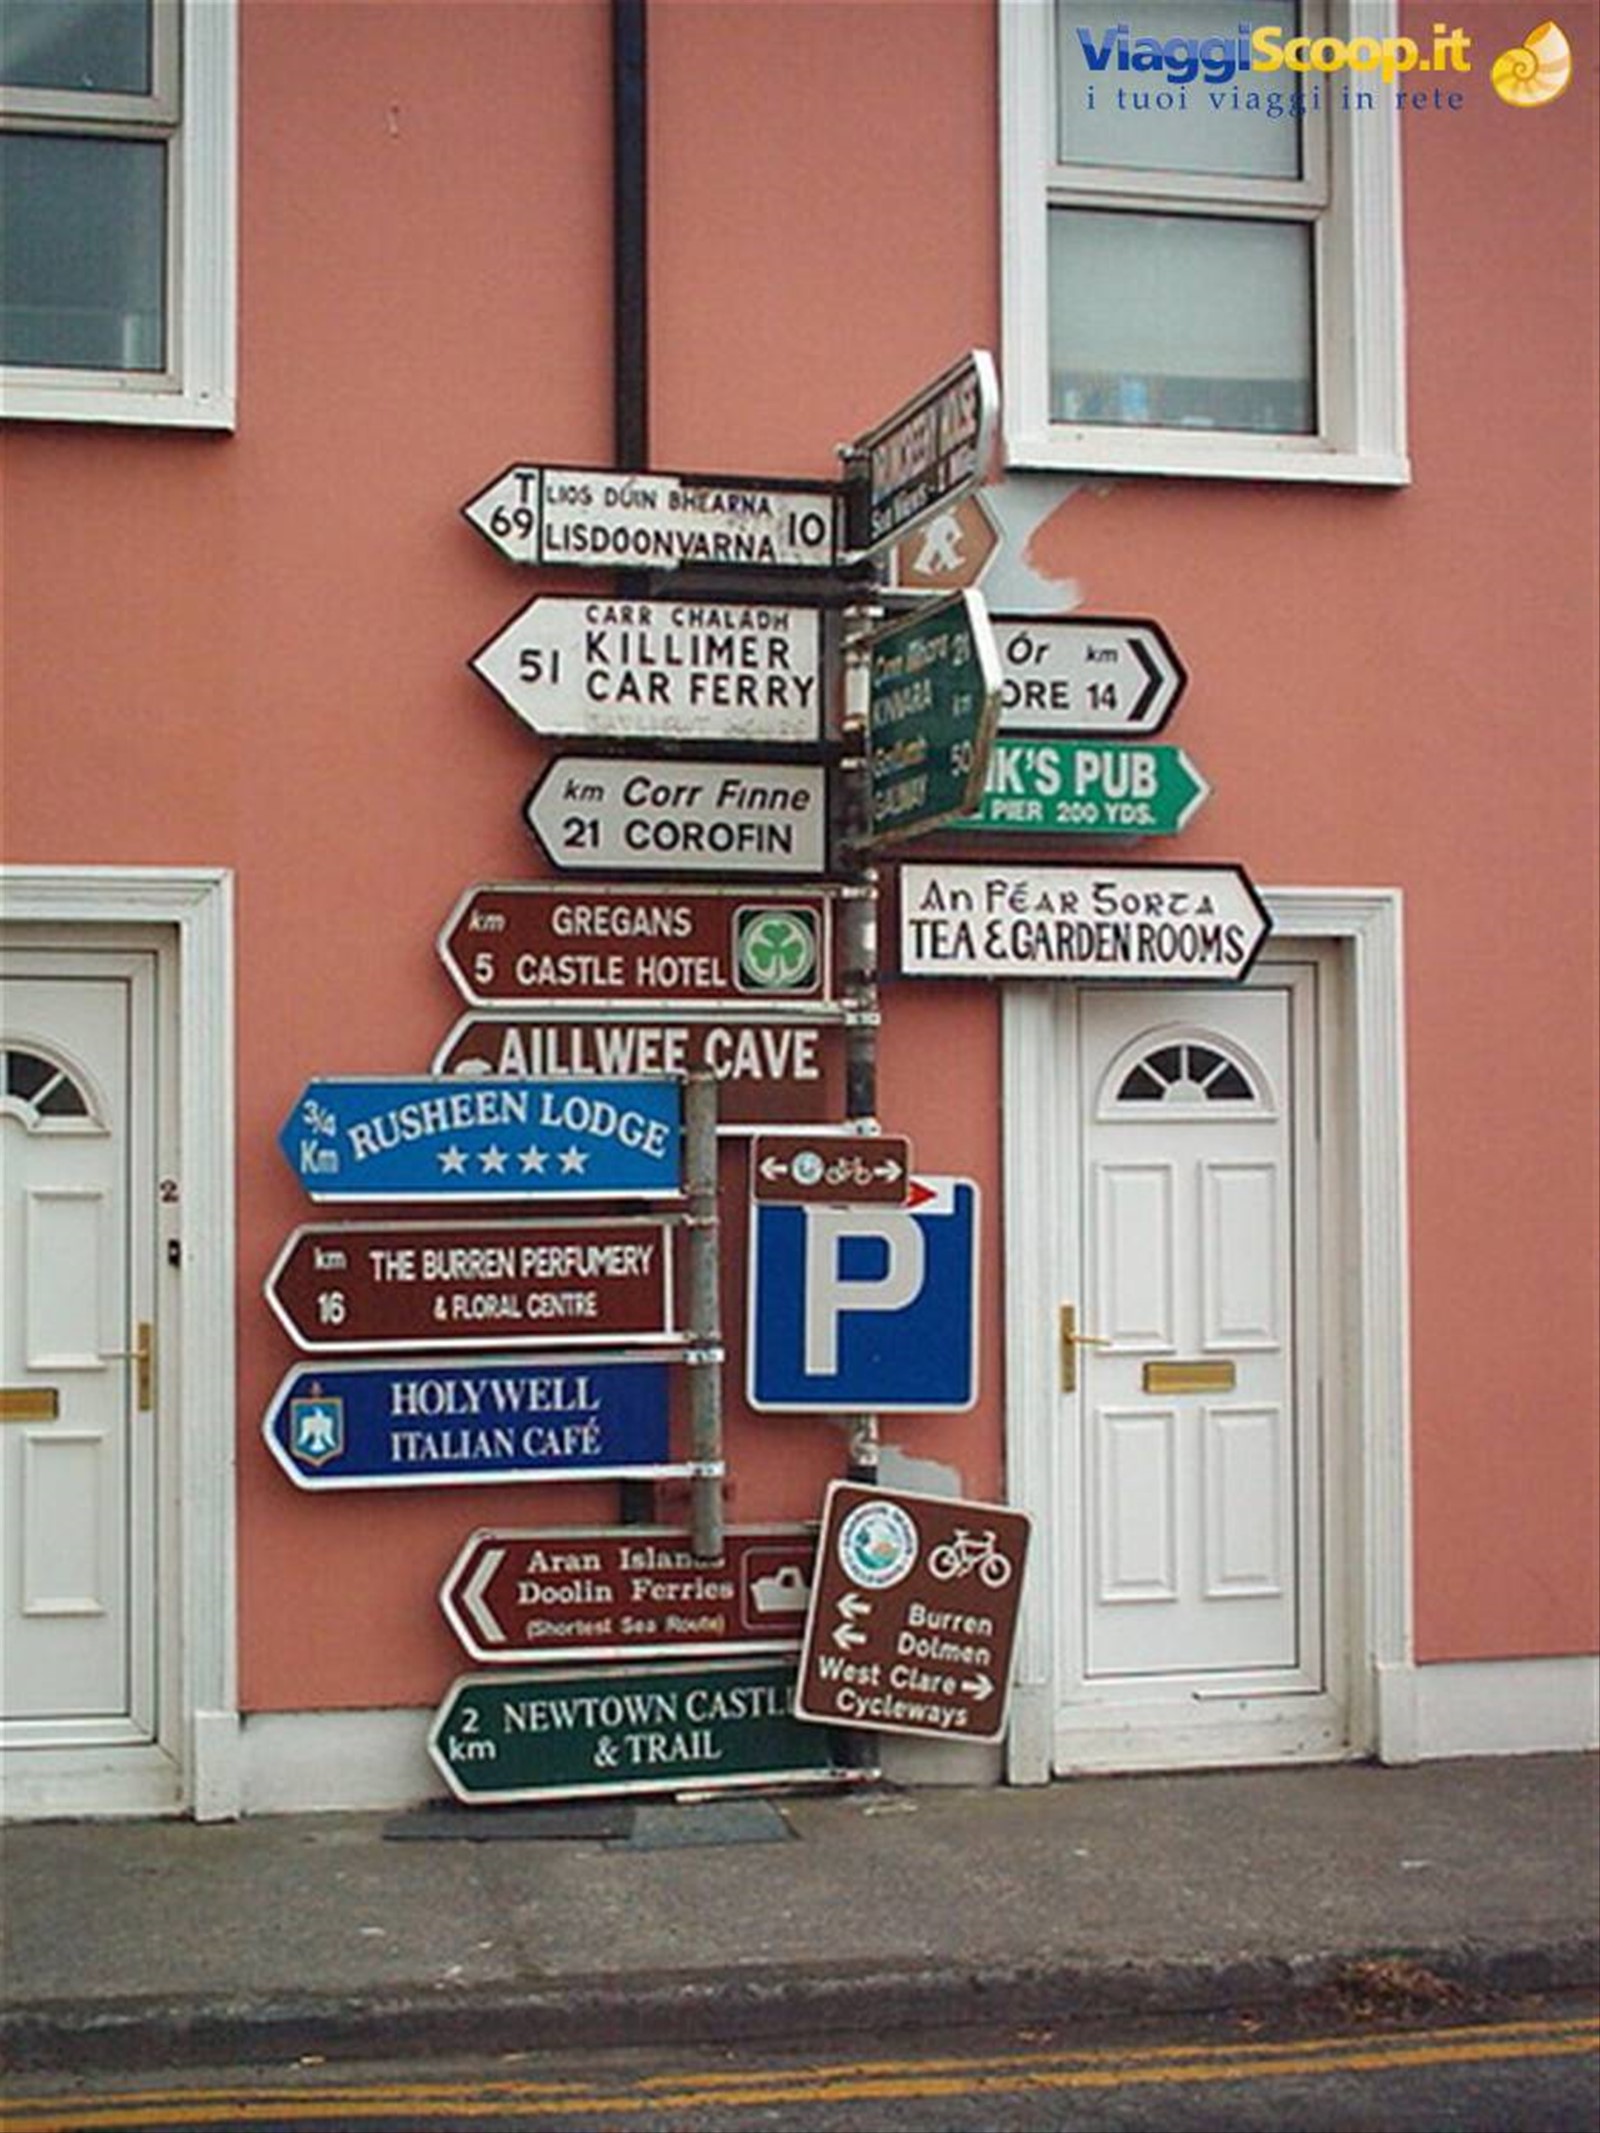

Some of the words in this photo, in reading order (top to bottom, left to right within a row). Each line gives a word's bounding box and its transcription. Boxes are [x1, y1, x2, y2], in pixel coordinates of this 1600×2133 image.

[513, 472, 535, 504] T
[547, 485, 593, 507] LIOS
[669, 491, 774, 516] BHEARNA
[490, 505, 535, 539] 69
[788, 512, 826, 548] 10
[546, 524, 777, 562] LISDOONVARNA
[586, 604, 651, 625] CARR
[671, 607, 789, 631] CHALADH
[586, 631, 790, 670] KILLIMER
[1006, 631, 1050, 665] Ór
[1087, 645, 1119, 663] km
[519, 649, 559, 685] 51
[586, 670, 671, 703] CAR
[690, 673, 815, 709] FERRY
[1087, 683, 1117, 709] 14
[1075, 751, 1158, 799] PUB
[563, 779, 604, 801] km
[622, 775, 704, 808] Corr
[715, 779, 812, 811] Finne
[990, 799, 1043, 821] PIER
[1057, 802, 1099, 824] 200
[563, 817, 601, 848] 21
[624, 819, 794, 854] COROFIN
[920, 879, 974, 912] An
[468, 911, 506, 933] km
[552, 905, 692, 937] GREGANS
[909, 919, 977, 960] TEA
[1011, 920, 1132, 963] GARDEN
[1138, 922, 1245, 965] ROOMS
[475, 953, 494, 983] 5
[515, 955, 624, 986] CASTLE
[638, 957, 727, 987] HOTEL
[499, 1027, 689, 1077] AILLWEE
[704, 1028, 820, 1079] CAVE
[347, 1091, 528, 1160] RUSHEEN
[540, 1092, 670, 1158] LODGE
[300, 1140, 339, 1174] Km
[160, 1179, 179, 1203] 2
[315, 1246, 346, 1270] km
[369, 1249, 416, 1282] THE
[423, 1248, 515, 1281] BURREN
[521, 1244, 654, 1278] PERFUMERY
[433, 1296, 447, 1320] &
[452, 1293, 522, 1320] FLORAL
[526, 1290, 598, 1318] CENTRE
[805, 1206, 925, 1375] P
[318, 1291, 345, 1325] 16
[390, 1376, 600, 1416] HOLYWELL
[390, 1427, 515, 1461] ITALIAN
[522, 1415, 602, 1457] CAFÉ
[528, 1549, 602, 1574] Aran
[518, 1580, 613, 1605] Doolin
[632, 1577, 735, 1601] Ferries
[526, 1618, 611, 1639] (Shortest
[620, 1615, 657, 1635] Sea
[908, 1603, 993, 1636] Burren
[897, 1631, 991, 1666] Dolmen
[818, 1655, 880, 1686] West
[889, 1665, 957, 1695] Clare
[462, 1707, 480, 1734] 2
[504, 1694, 678, 1732] NEWTOWN
[836, 1687, 968, 1729] Cycleways
[448, 1737, 497, 1761] km
[594, 1737, 619, 1767] &
[625, 1731, 722, 1765] TRAIL
